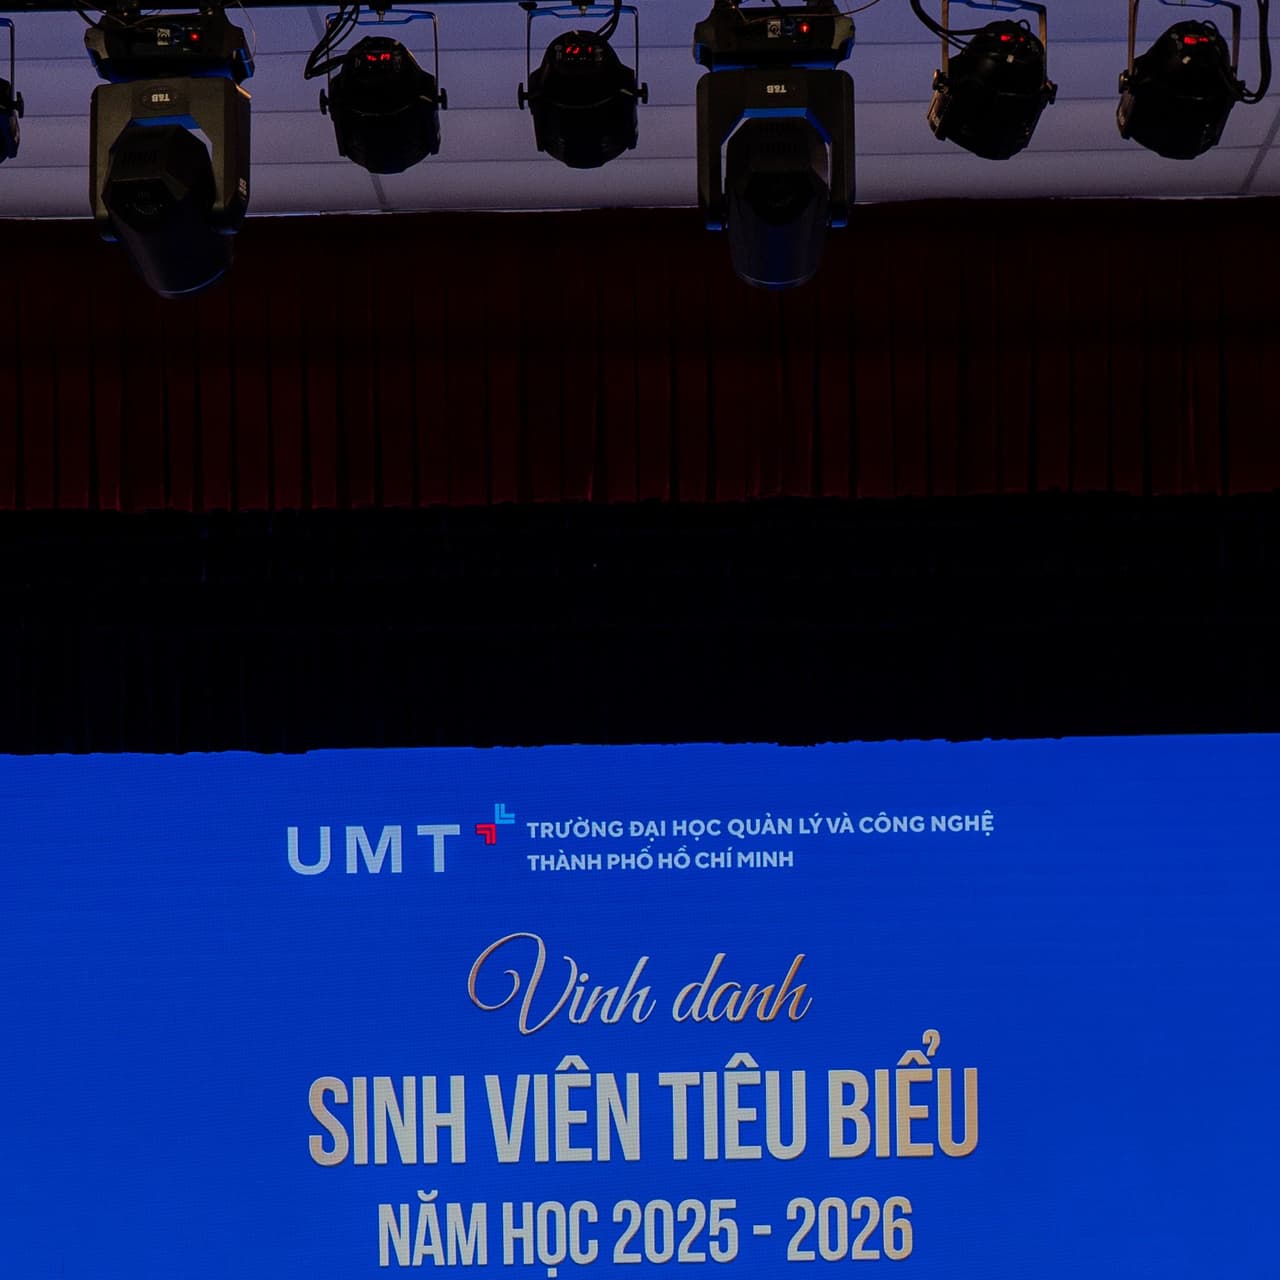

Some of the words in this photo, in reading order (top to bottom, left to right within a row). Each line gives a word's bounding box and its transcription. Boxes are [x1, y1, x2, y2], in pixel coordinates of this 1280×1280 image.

[151, 93, 170, 103] T&B
[286, 824, 461, 875] UMT
[527, 816, 624, 838] TRƯỜNG
[630, 820, 666, 842] ĐẠI
[673, 819, 721, 841] HỌC
[727, 812, 793, 839] QUẢN
[799, 812, 823, 834] LÝ
[826, 812, 855, 834] VÀ
[859, 811, 925, 833] CÔNG
[931, 810, 994, 836] NGHỆ
[527, 849, 602, 871] THÀNH
[608, 845, 653, 870] PHỐ
[658, 845, 691, 869] HỒ
[695, 846, 732, 868] CHÍ
[737, 851, 793, 868] MINH
[467, 931, 656, 1035] Vinh
[672, 952, 813, 1023] danh
[308, 1075, 468, 1166] SINH
[484, 1054, 639, 1164] VIÊN
[657, 1051, 807, 1160] TIÊU
[828, 1028, 980, 1158] BIỂU
[377, 1190, 488, 1268] NĂM
[502, 1199, 598, 1278] HỌC
[612, 1198, 738, 1264] 2025
[753, 1224, 771, 1236] -
[786, 1196, 913, 1262] 2026
